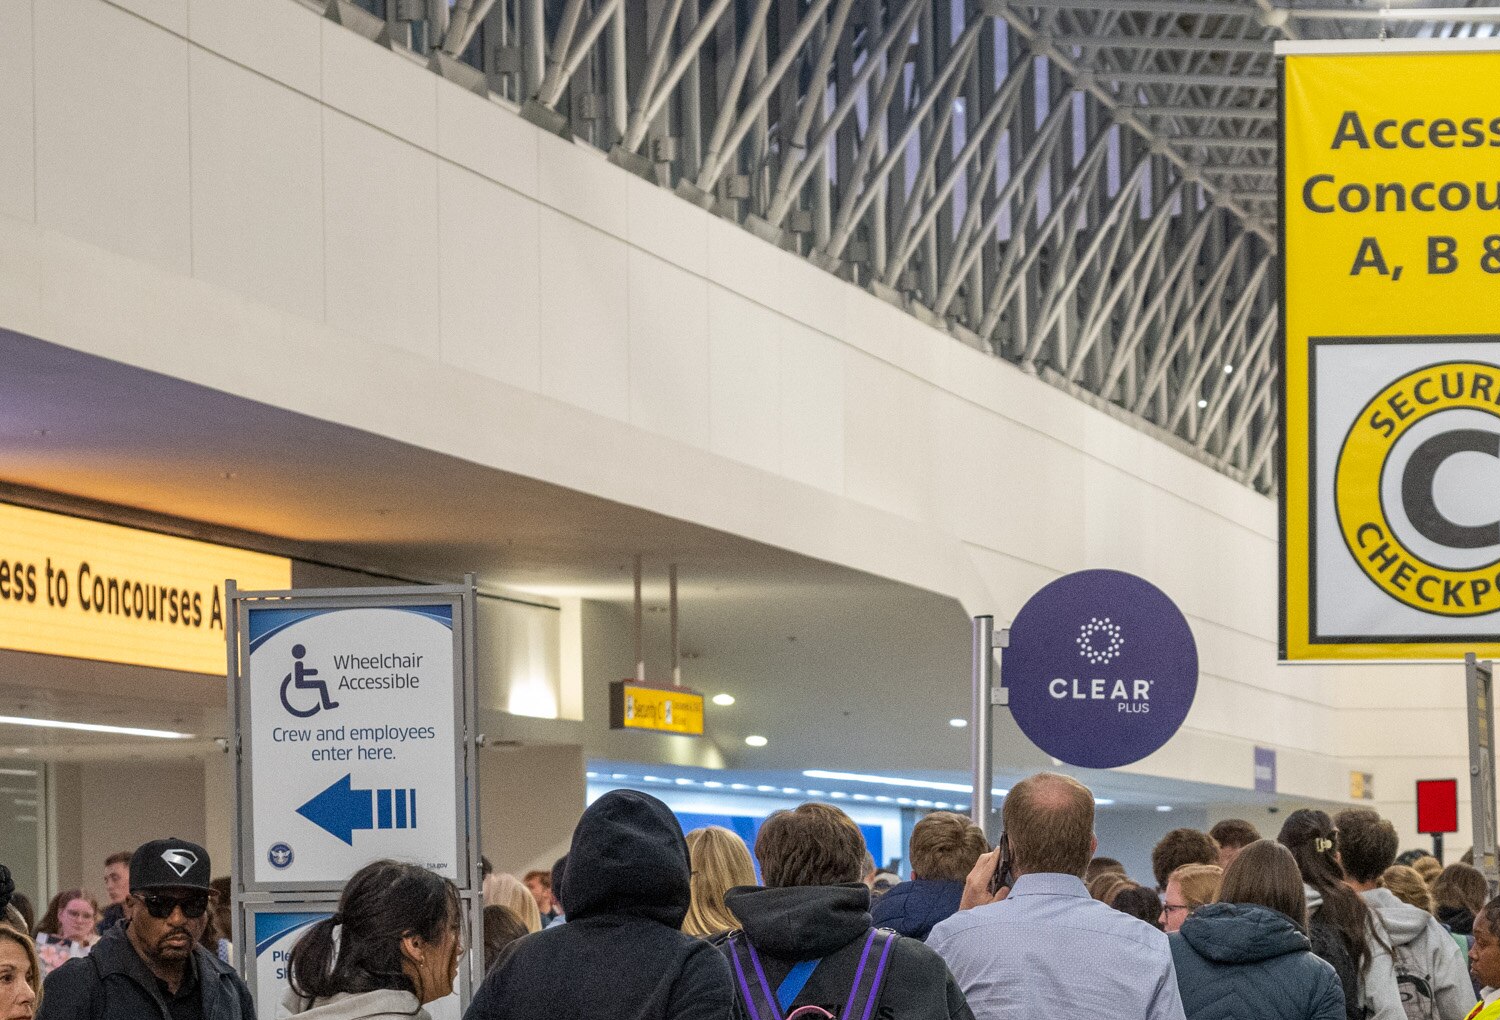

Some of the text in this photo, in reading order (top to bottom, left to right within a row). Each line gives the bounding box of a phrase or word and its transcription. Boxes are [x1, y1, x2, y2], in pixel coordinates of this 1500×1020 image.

[1350, 237, 1403, 281] A,
[1428, 236, 1459, 275] B
[45, 556, 69, 608] to
[77, 561, 203, 628] Concourses
[333, 652, 424, 670] Wheelchair
[338, 673, 420, 690] Accessible
[1048, 677, 1150, 700] CLEAR
[1117, 702, 1150, 714] PLUS
[272, 724, 435, 743] Crew and employees
[311, 745, 396, 761] enter here.
